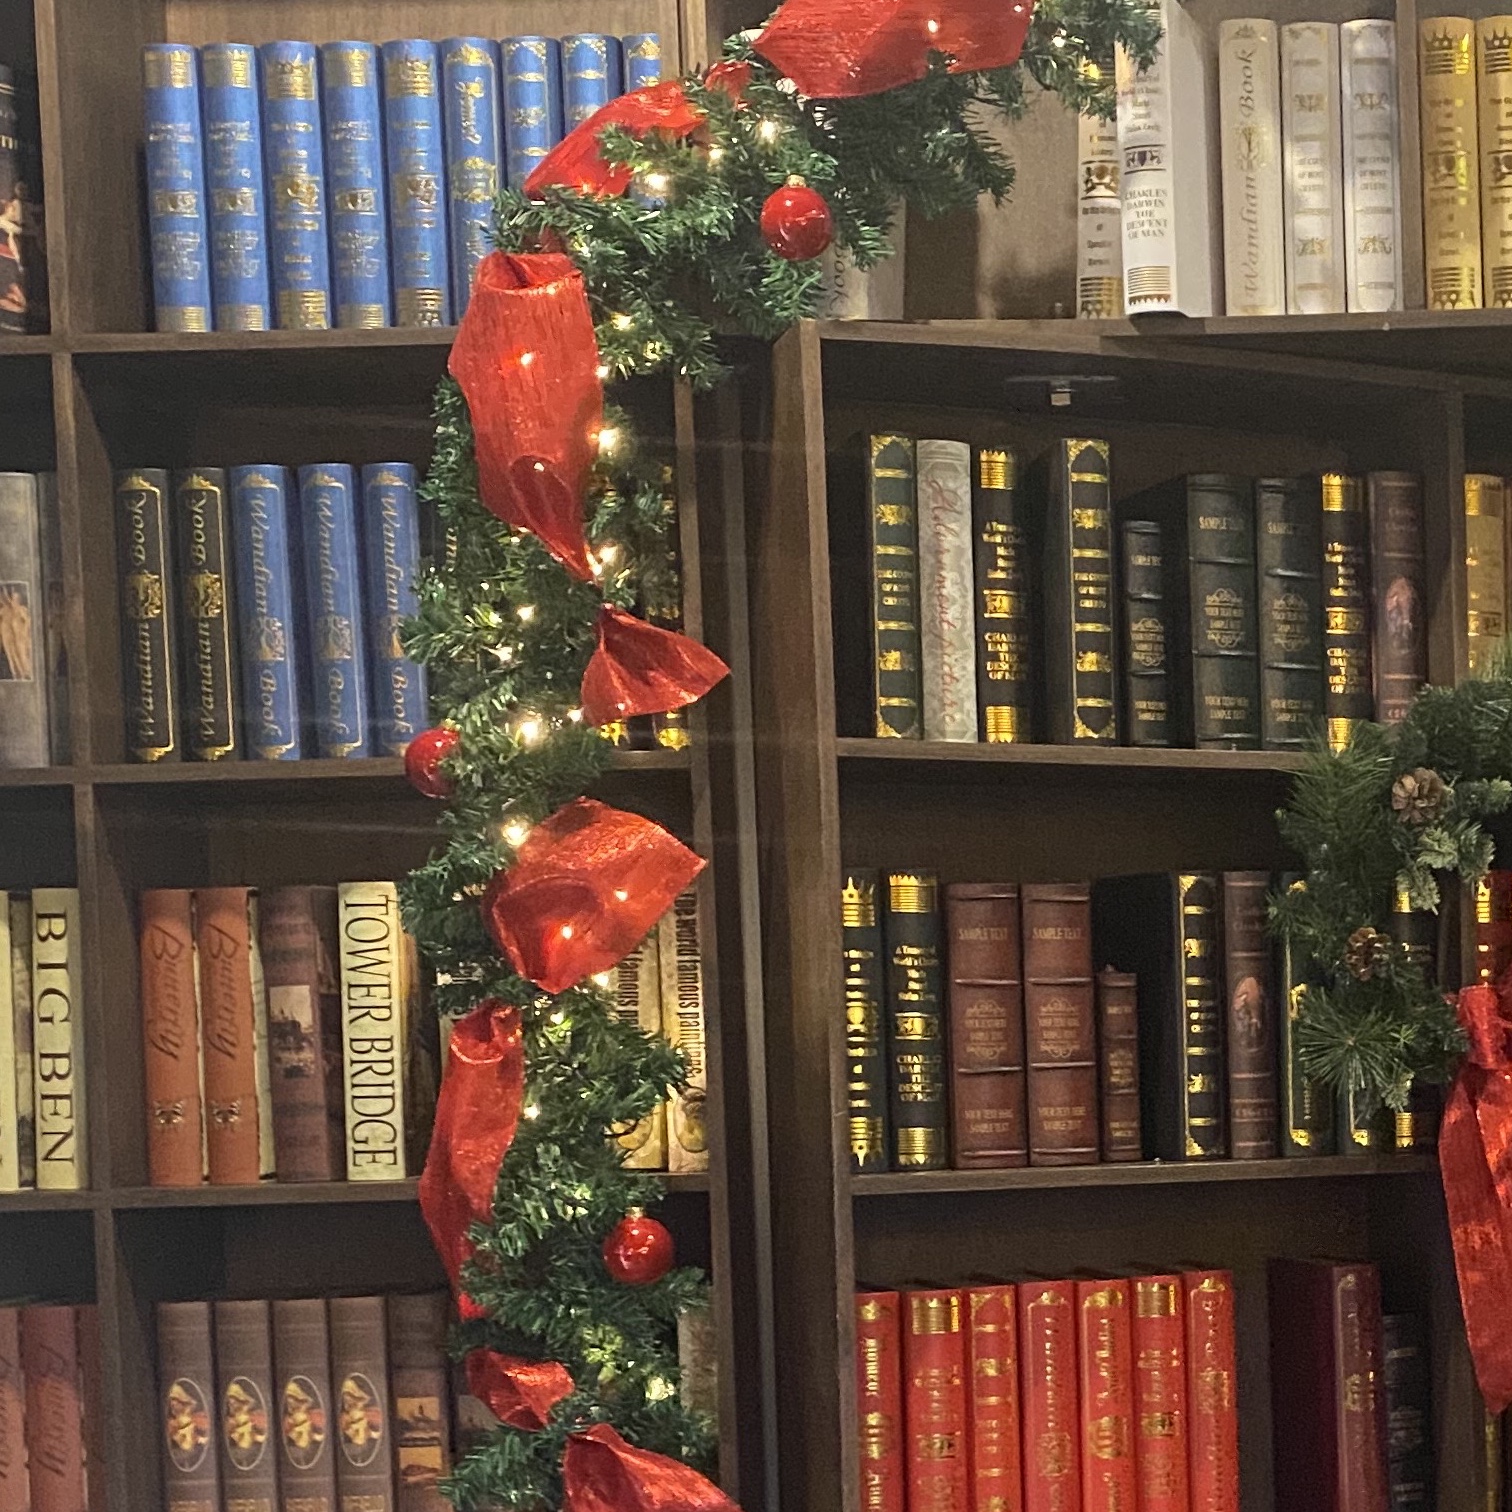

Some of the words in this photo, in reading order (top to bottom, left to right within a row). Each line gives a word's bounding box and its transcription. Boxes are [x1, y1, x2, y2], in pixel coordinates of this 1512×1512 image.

[1239, 50, 1256, 118] Book
[250, 494, 273, 614] Wandian
[317, 493, 340, 614] Wandian
[381, 493, 404, 612] Wandian
[259, 669, 281, 737] Book
[328, 668, 349, 734] Book
[391, 666, 413, 733] Book
[35, 911, 71, 1026] BIG
[343, 894, 394, 1024] TOWER
[676, 959, 702, 1009] famous
[38, 1052, 75, 1164] BEN
[348, 1036, 399, 1168] BRIDGE
